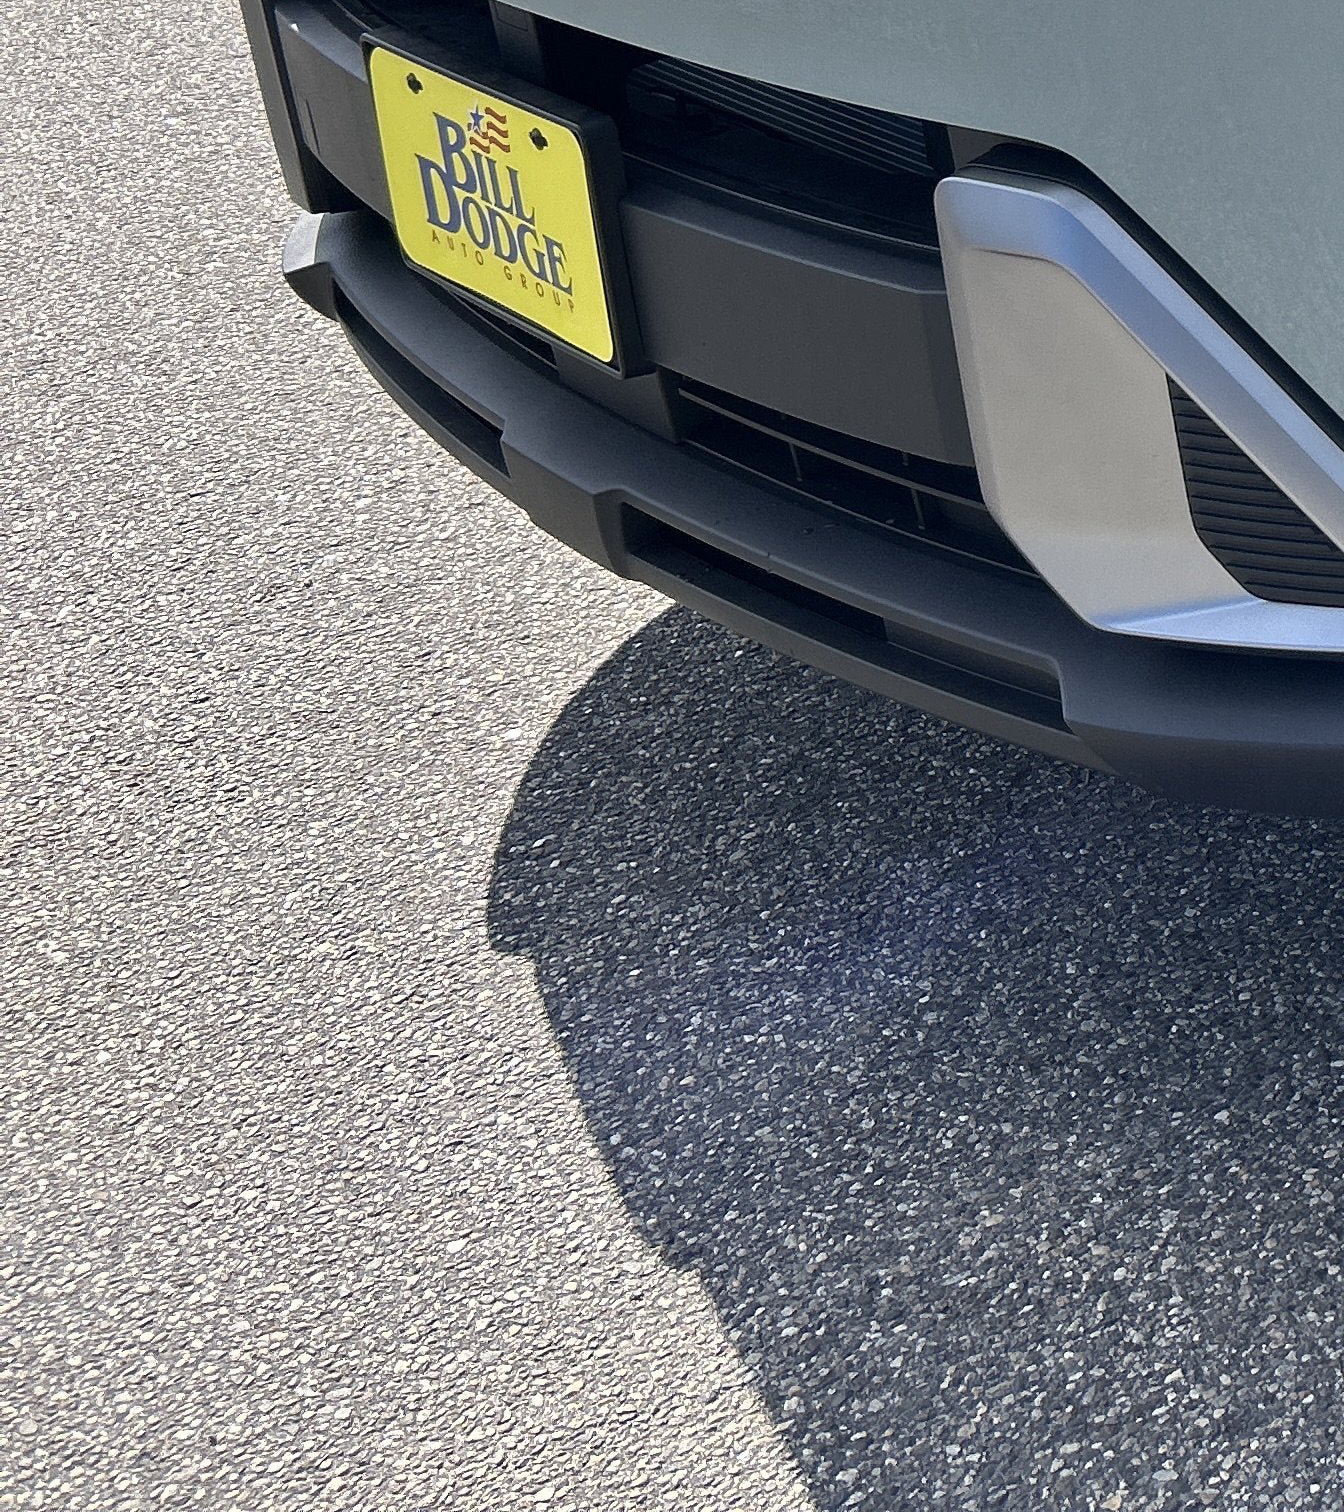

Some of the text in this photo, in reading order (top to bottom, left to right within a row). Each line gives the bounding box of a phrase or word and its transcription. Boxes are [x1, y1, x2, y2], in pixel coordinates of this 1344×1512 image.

[414, 152, 574, 296] DODGE
[433, 111, 535, 227] BILL
[432, 229, 575, 314] AUTO GROUP
